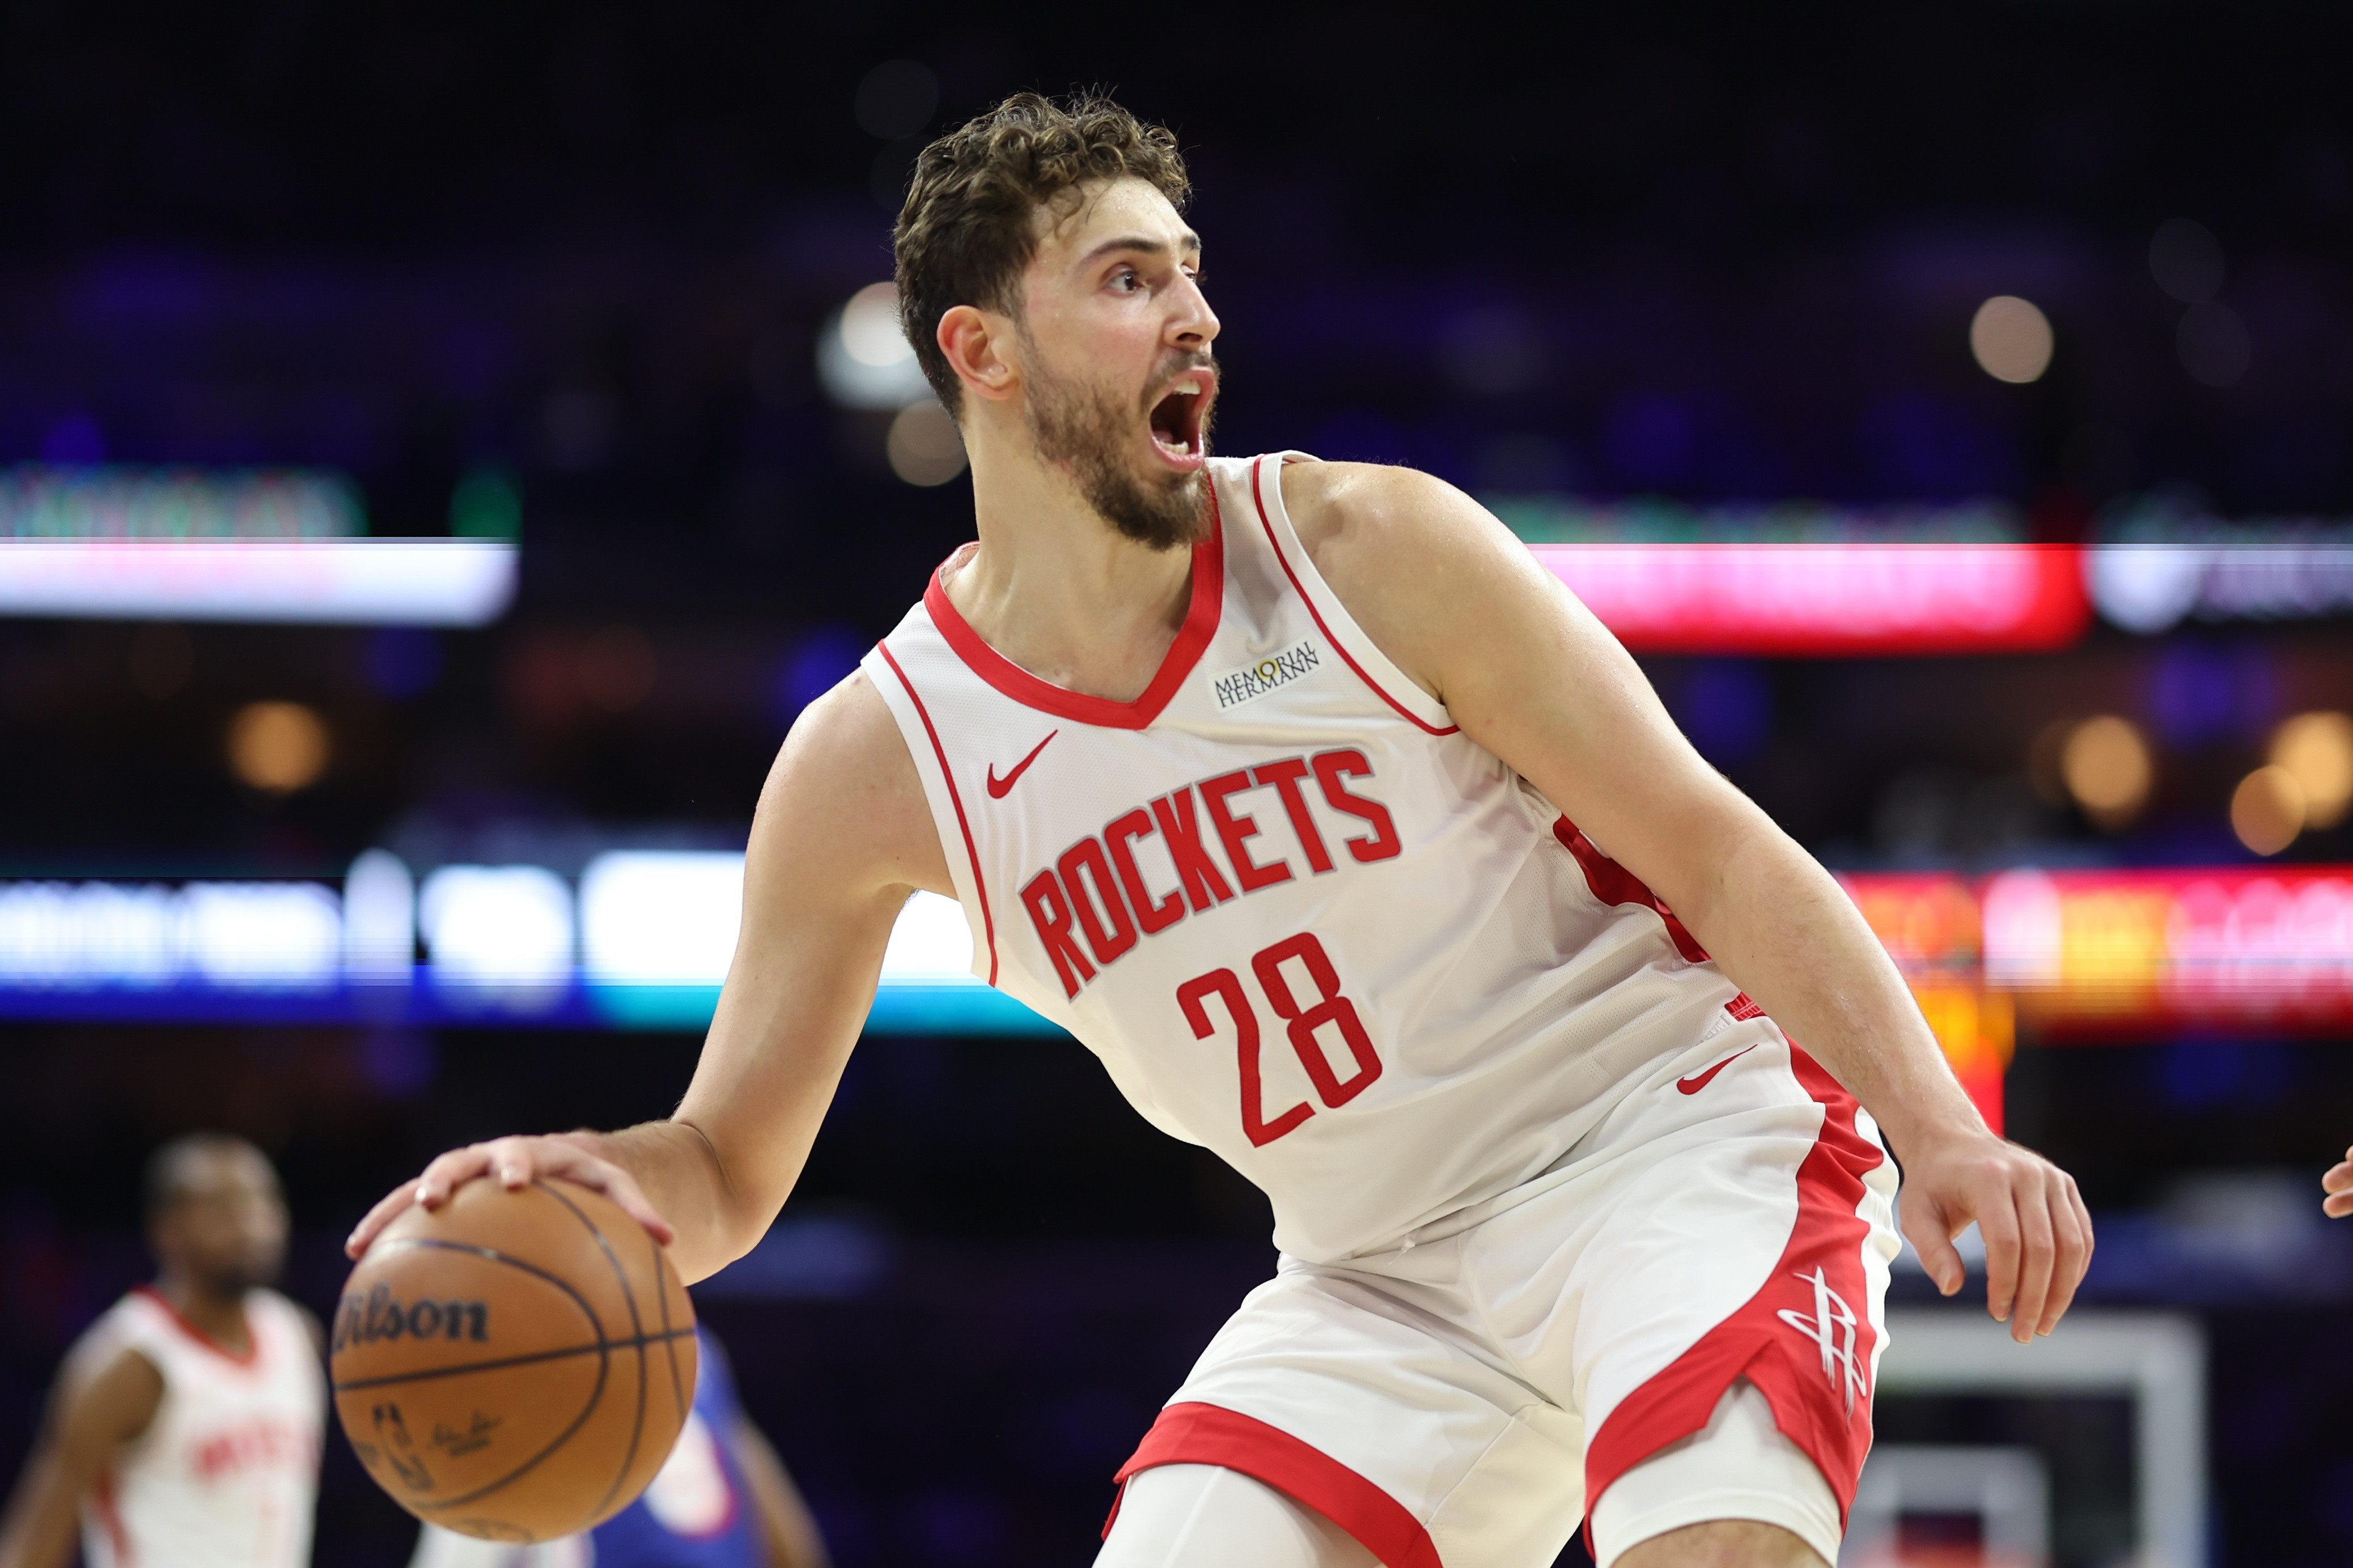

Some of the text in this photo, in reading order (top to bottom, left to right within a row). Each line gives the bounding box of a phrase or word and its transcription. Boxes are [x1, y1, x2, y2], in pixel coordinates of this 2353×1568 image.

[1215, 641, 1316, 693] MEMORIAL
[1219, 652, 1320, 708] HERMANN
[1017, 747, 1403, 1004] ROCKETS
[1176, 931, 1383, 1149] 28
